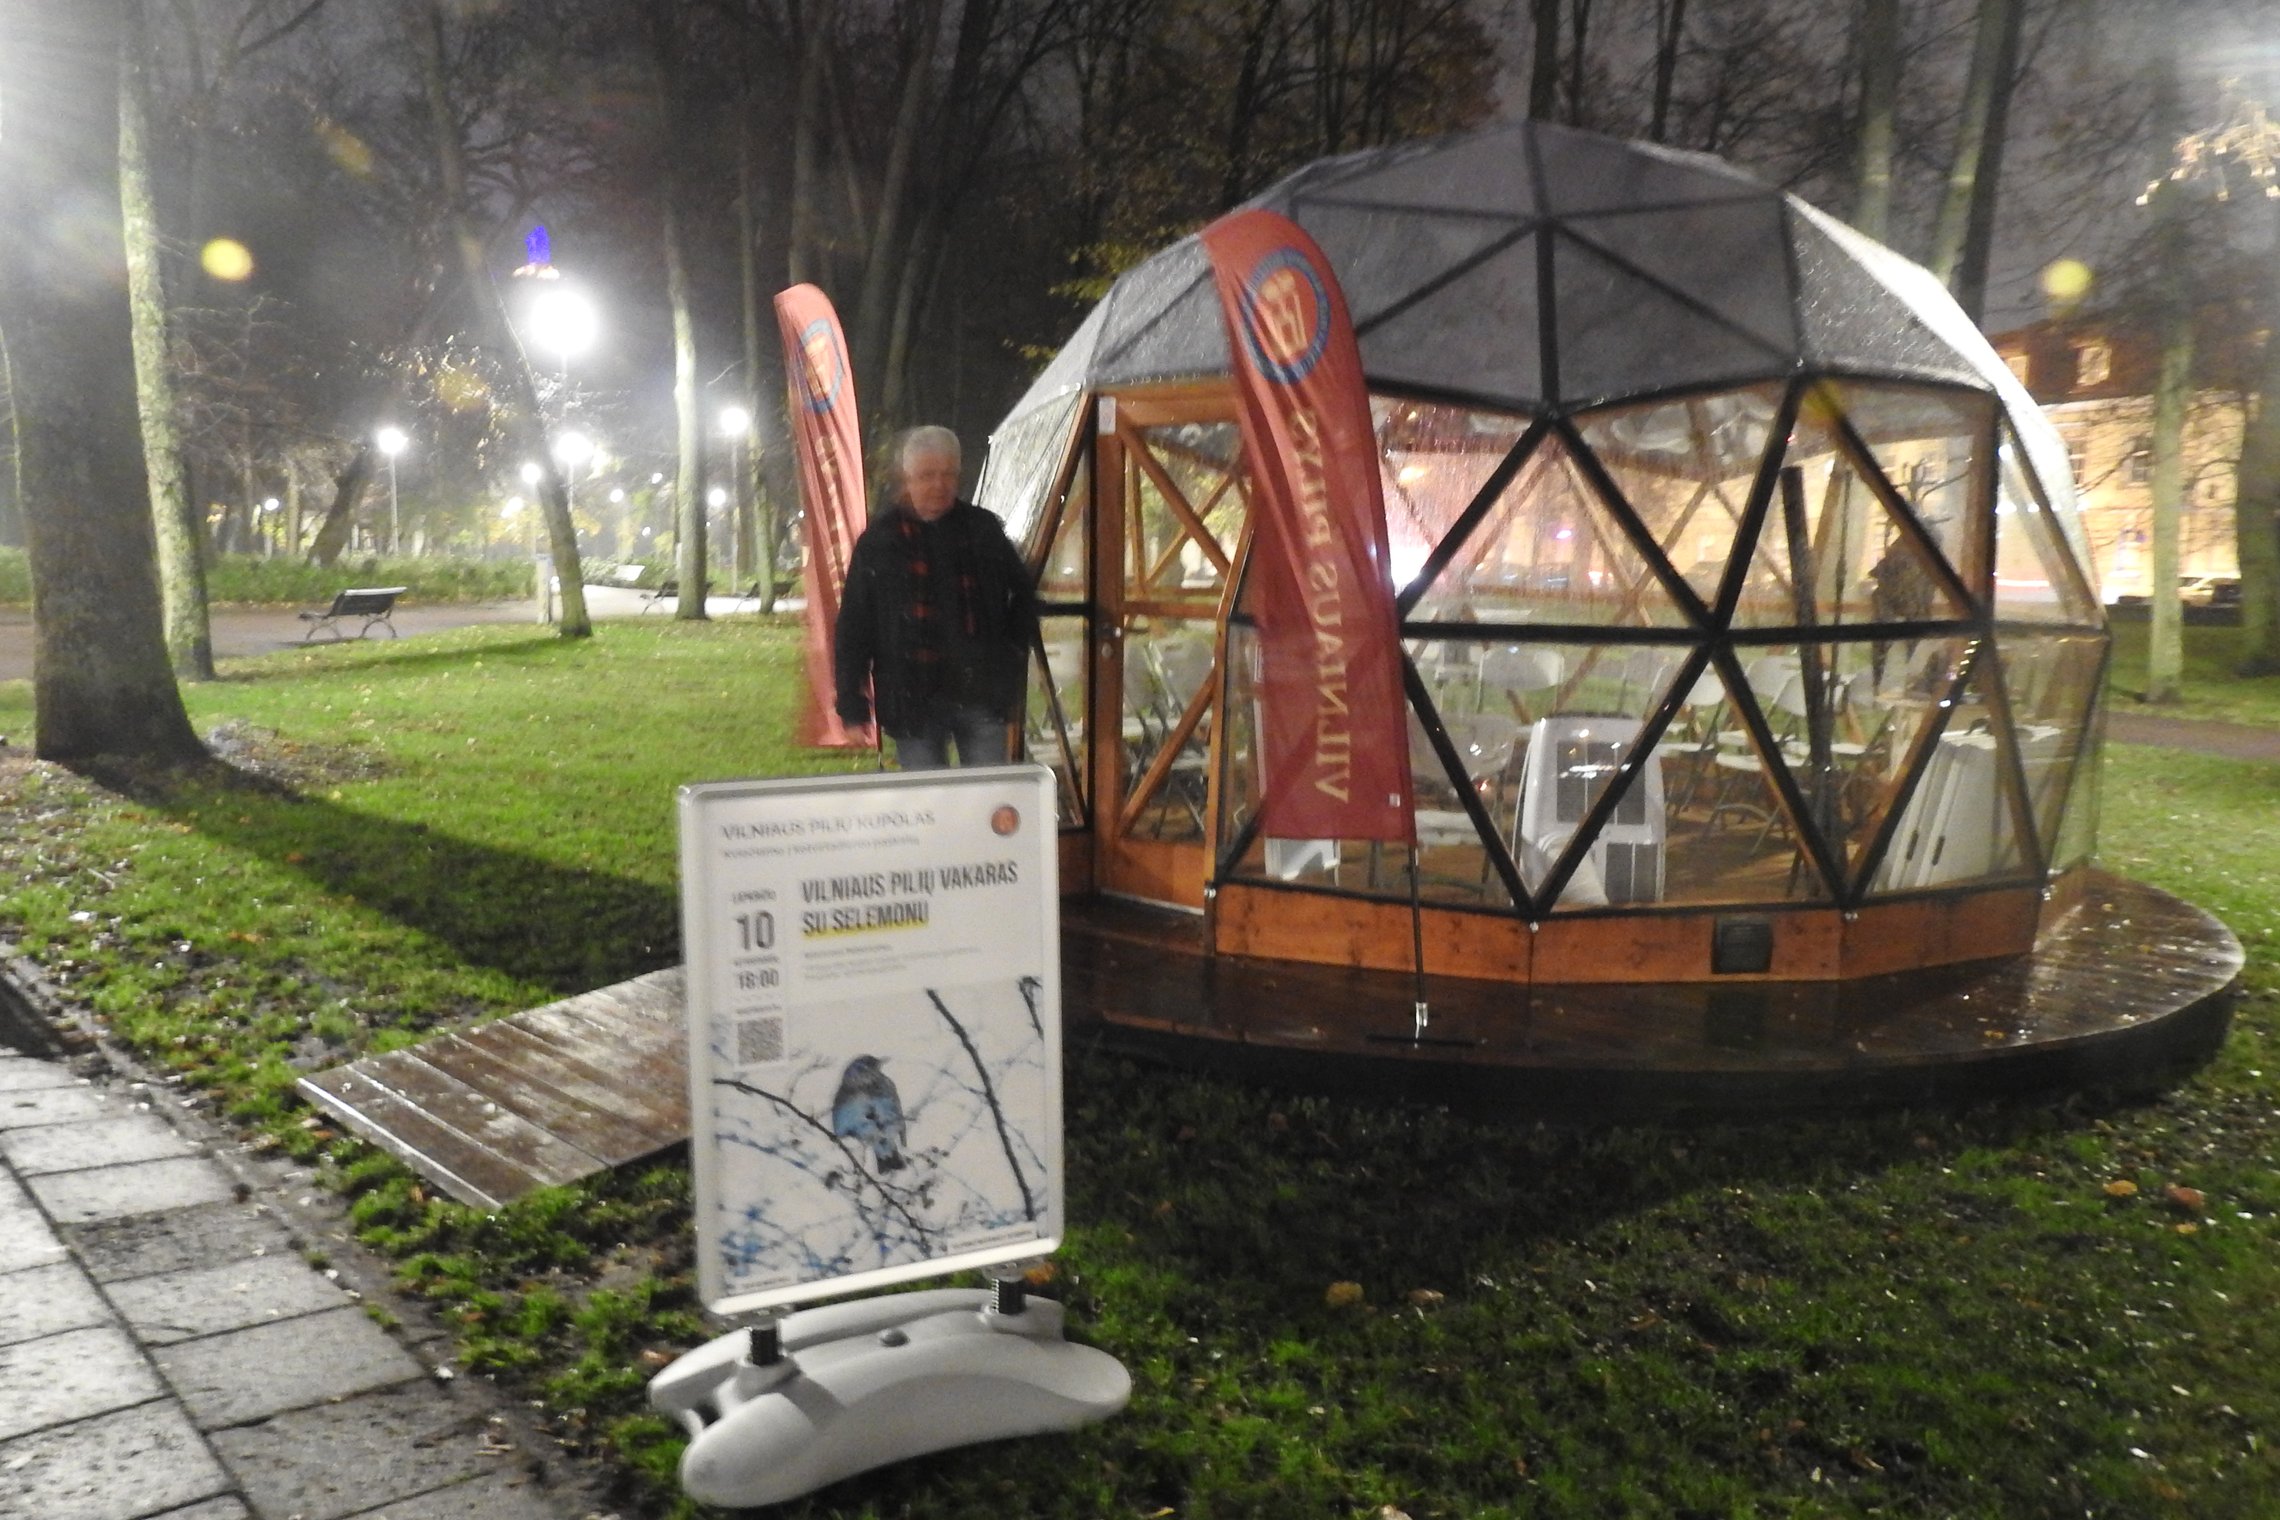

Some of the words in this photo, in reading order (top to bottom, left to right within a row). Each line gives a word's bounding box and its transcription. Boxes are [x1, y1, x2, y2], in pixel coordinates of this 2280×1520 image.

[802, 872, 886, 904] VILNIAUS
[939, 860, 1019, 890] VAKARAS
[735, 909, 775, 951] 10
[802, 910, 828, 937] SU
